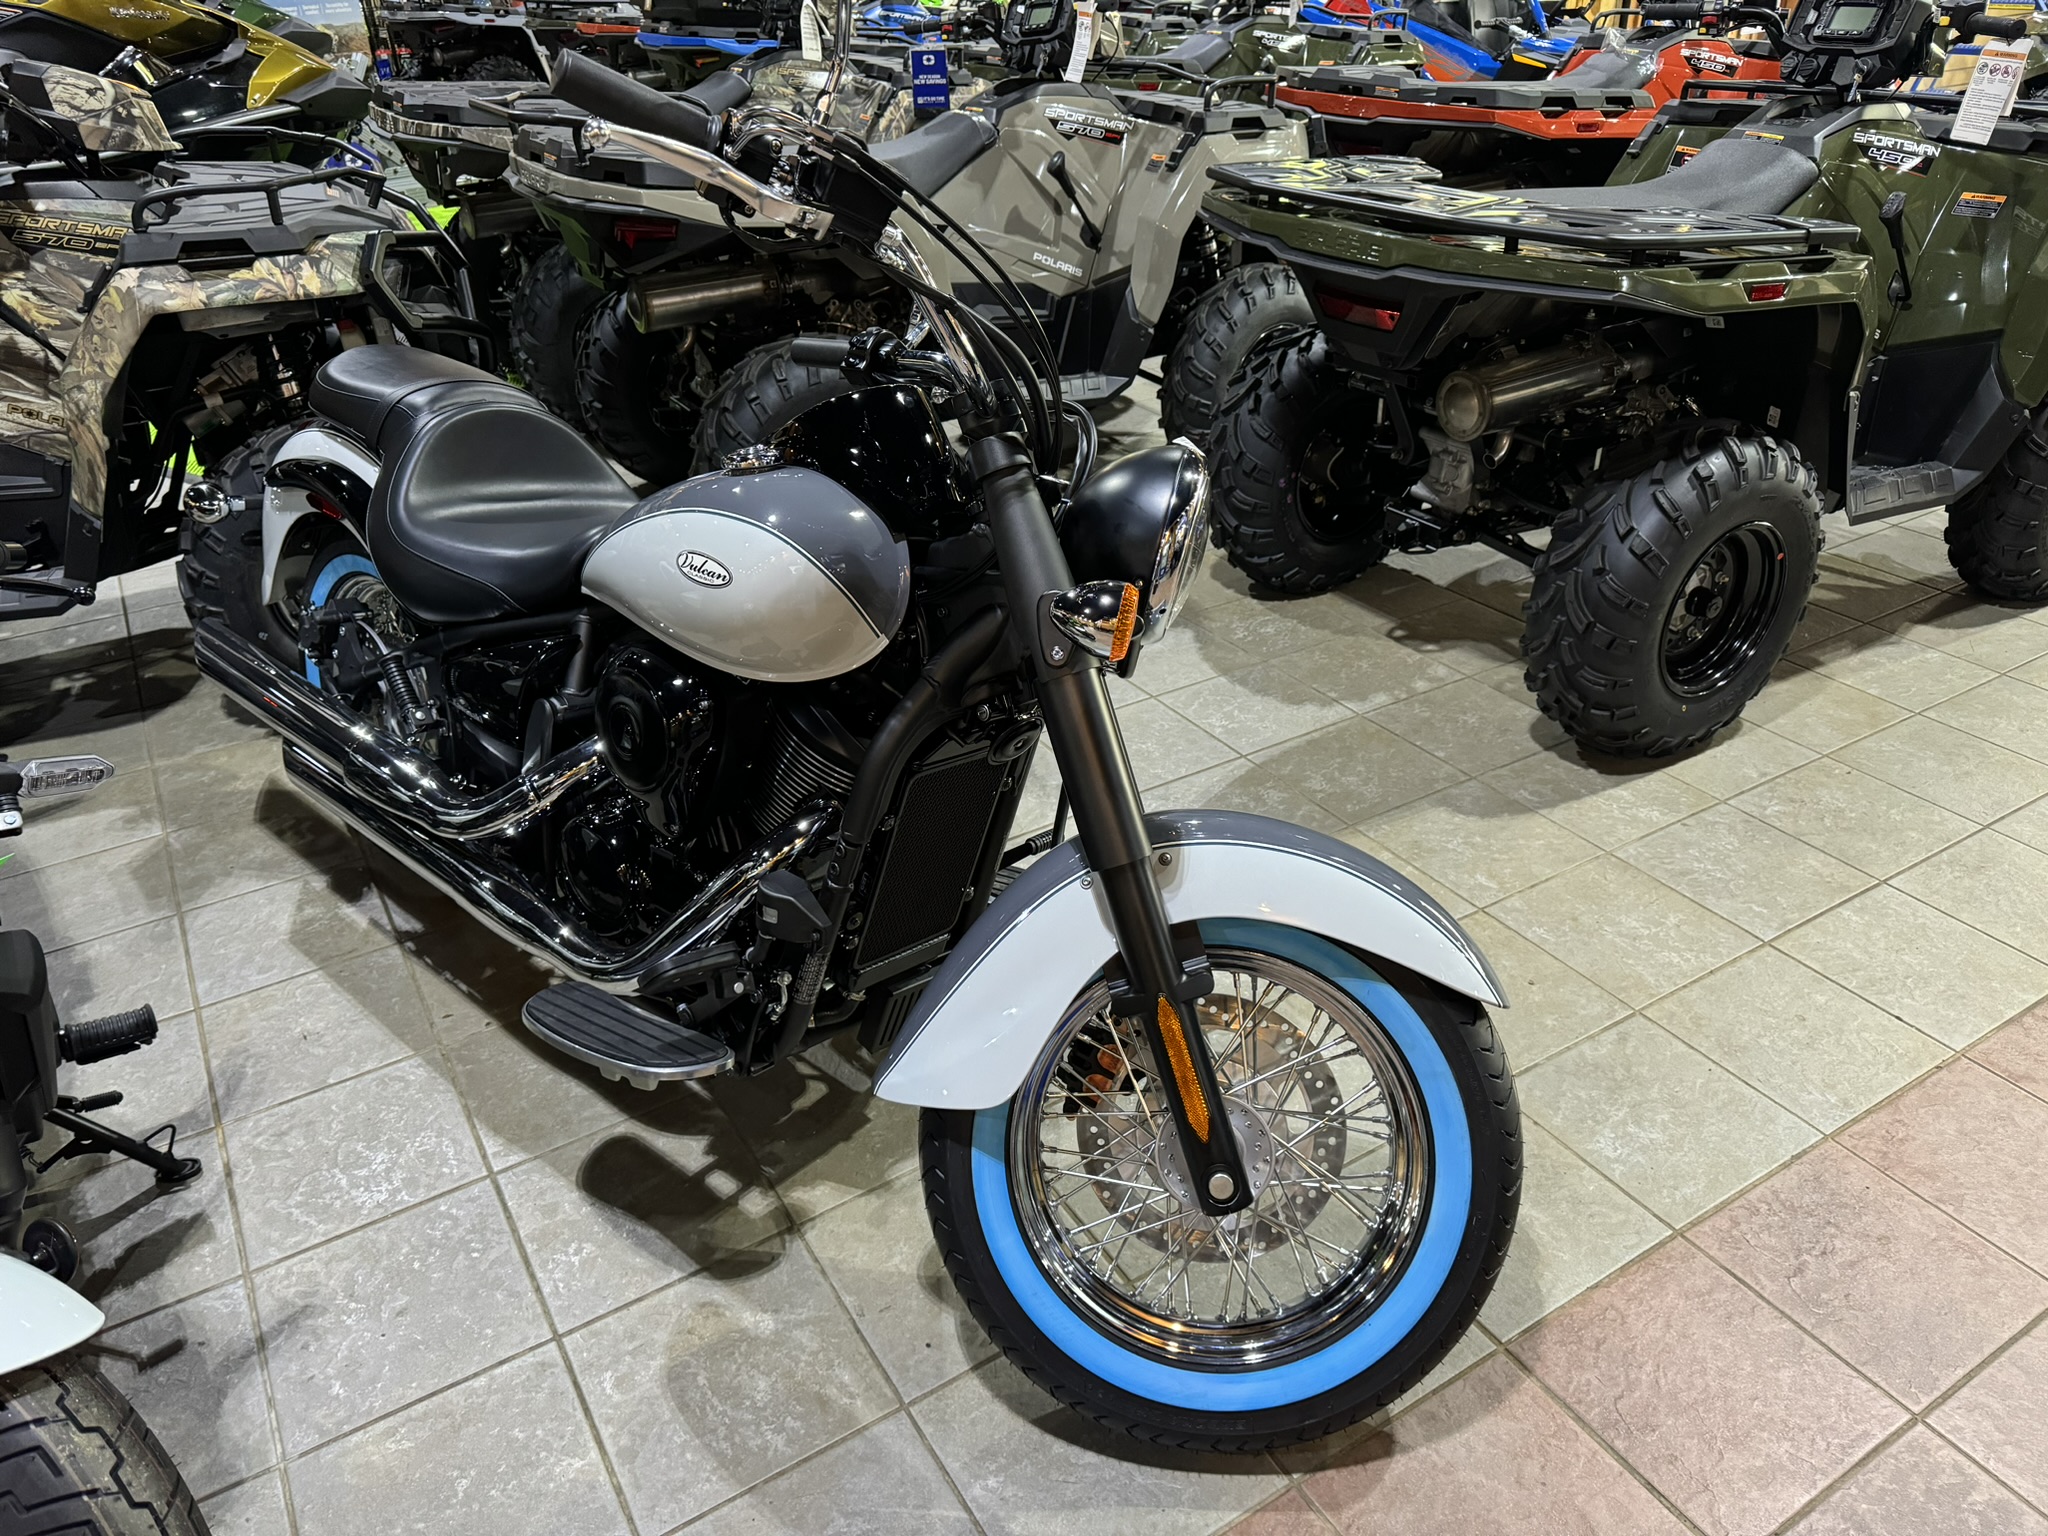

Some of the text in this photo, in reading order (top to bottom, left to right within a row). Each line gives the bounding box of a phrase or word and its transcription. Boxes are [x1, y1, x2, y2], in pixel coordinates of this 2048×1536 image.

[1680, 48, 1743, 67] SPORTSMAN
[1691, 58, 1726, 72] 450
[1043, 107, 1135, 131] SPORTSMAN
[1056, 120, 1106, 139] 570
[1852, 131, 1941, 157] SPORTSMAN
[0, 212, 128, 239] SPORTSMA
[12, 228, 95, 251] 570
[1033, 251, 1083, 277] POLARIS
[7, 403, 66, 428] POLA
[680, 553, 728, 582] Vulcan
